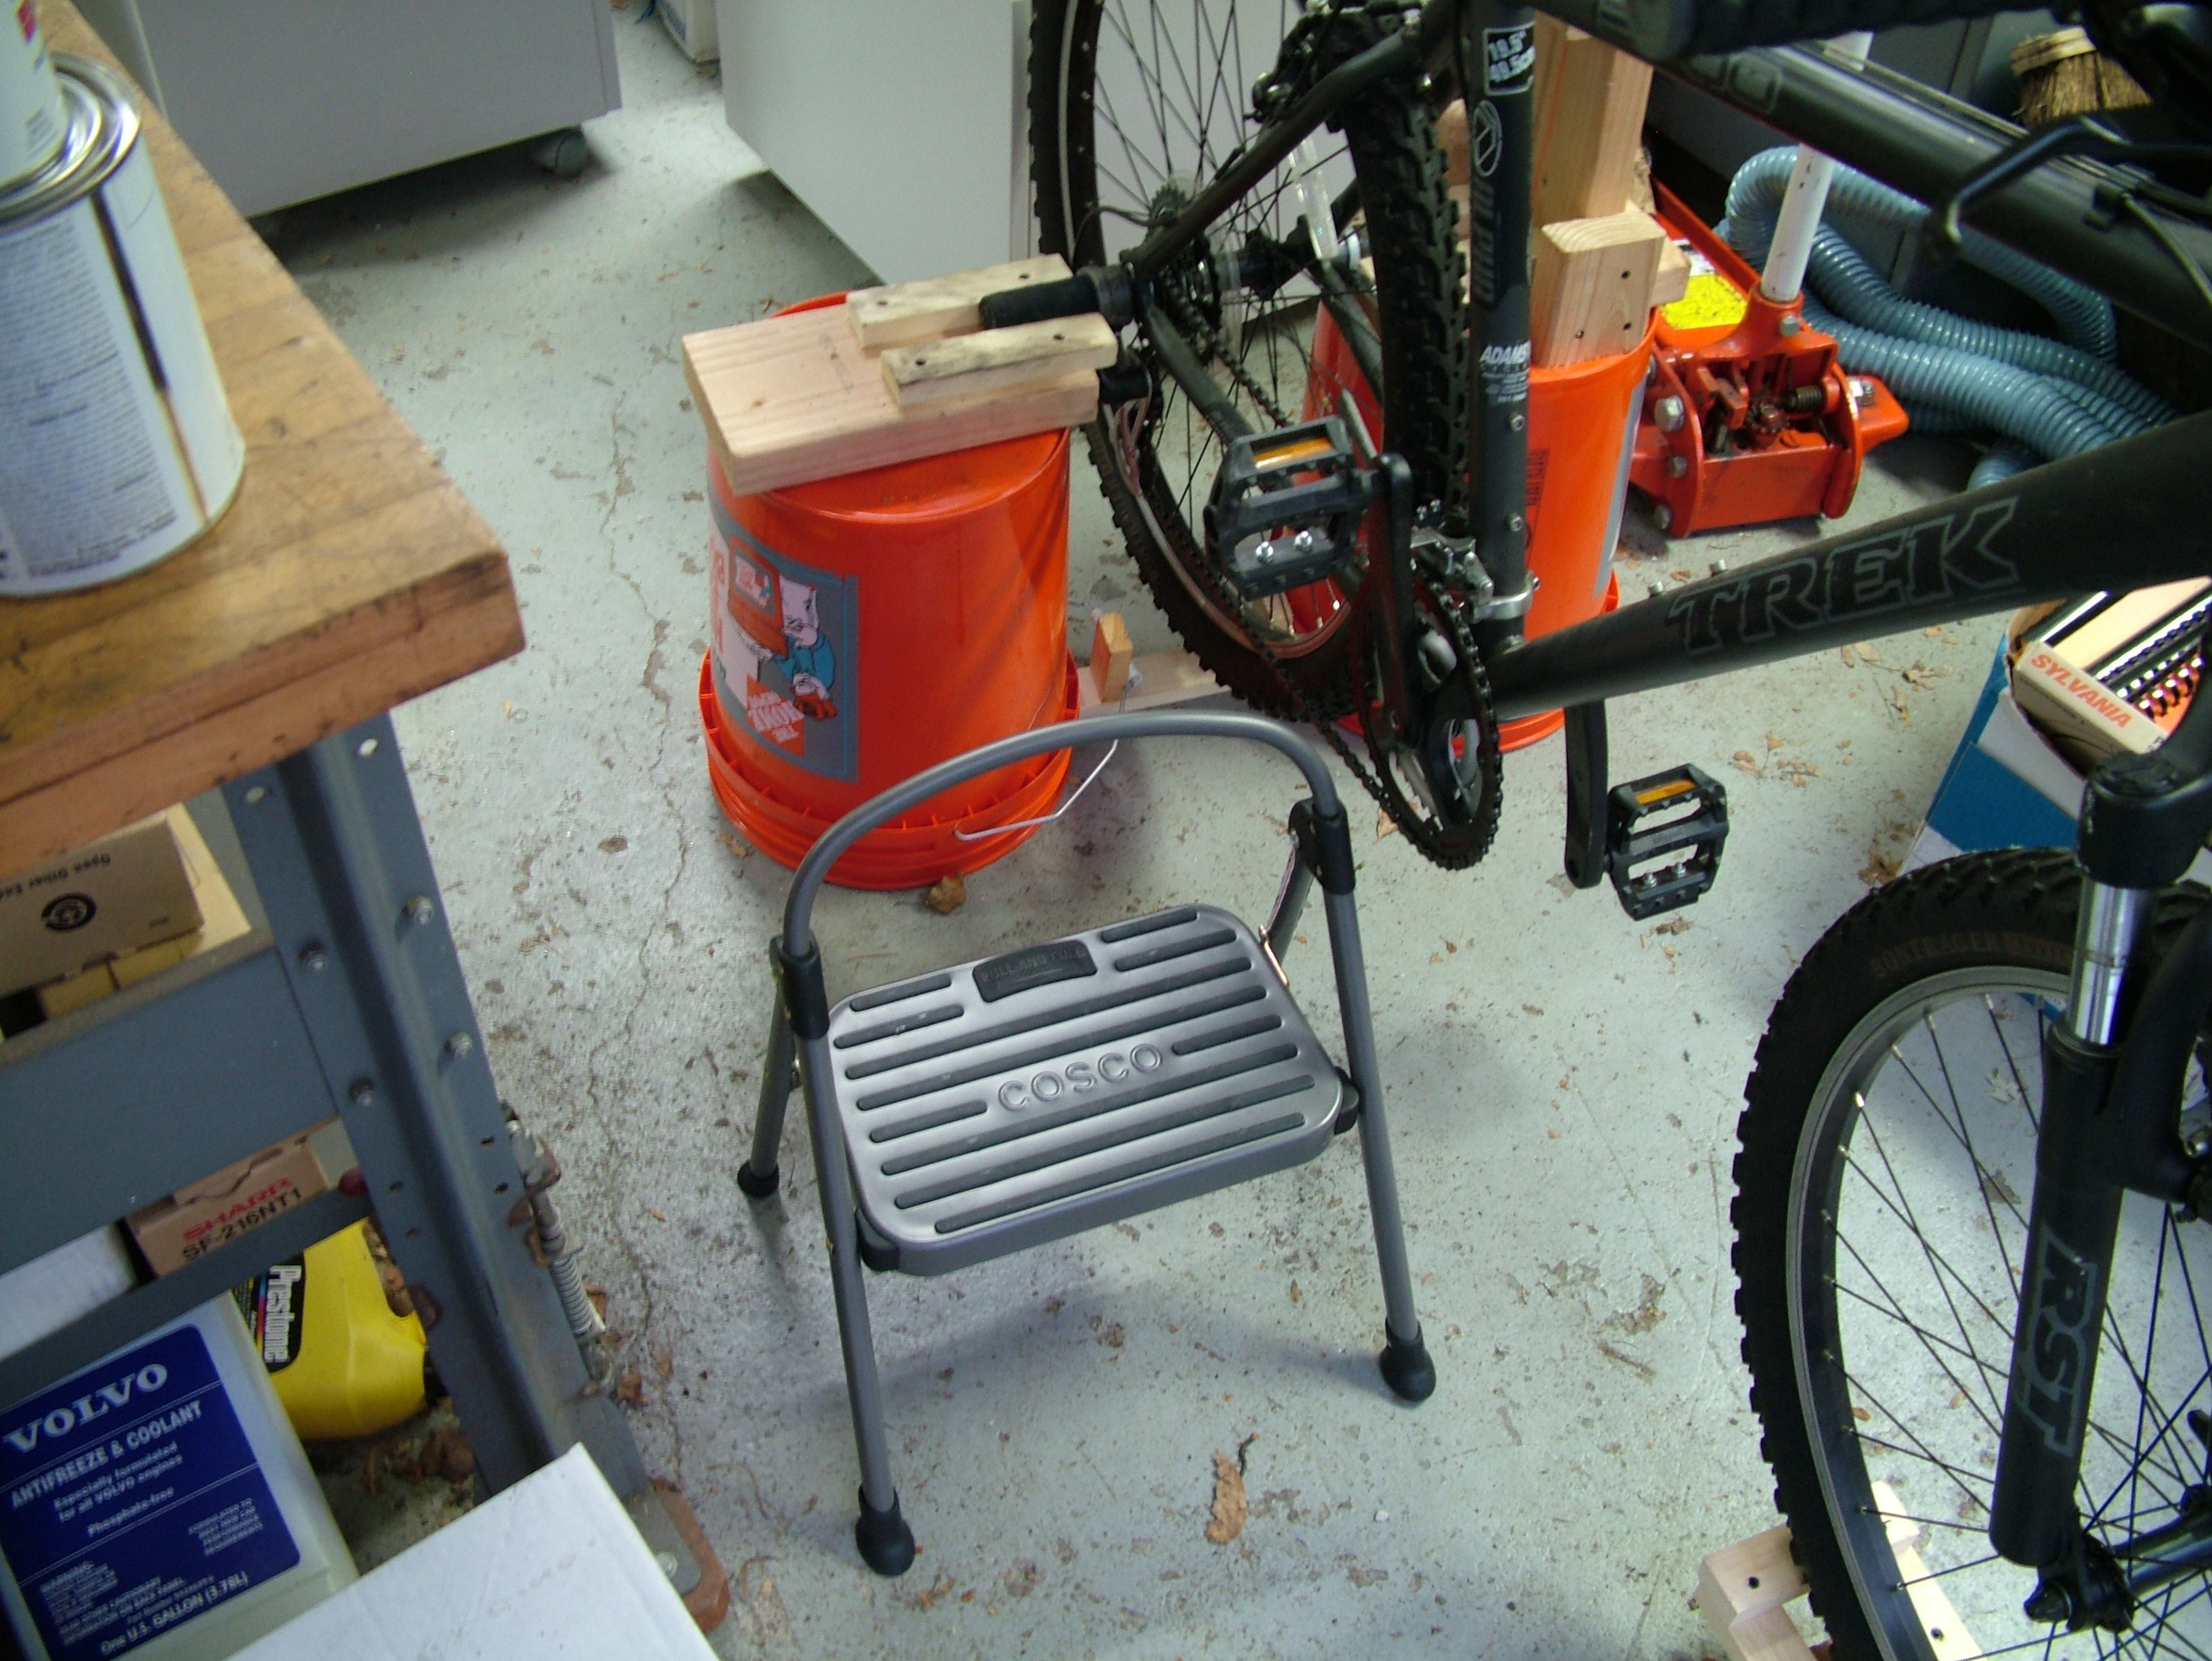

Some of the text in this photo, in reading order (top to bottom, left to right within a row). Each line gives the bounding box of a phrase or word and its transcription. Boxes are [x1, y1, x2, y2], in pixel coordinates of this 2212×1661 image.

[1665, 495, 2022, 656] TREK
[2031, 652, 2132, 729] SYLVANIA
[73, 852, 111, 874] Open
[997, 1042, 1164, 1112] COSCO
[183, 1176, 294, 1242] SHARP
[264, 1264, 303, 1364] Prestone
[2014, 1222, 2098, 1458] RST
[3, 1363, 168, 1454] VOLVO
[10, 1399, 203, 1510] ANTIFREEZE & COOLANT
[53, 1440, 178, 1511] Especially formulated
[58, 1454, 184, 1523] for all VOLVO engines
[87, 1486, 175, 1538] Phosphate-free
[101, 1634, 127, 1656] One
[152, 1593, 204, 1627] GALLON
